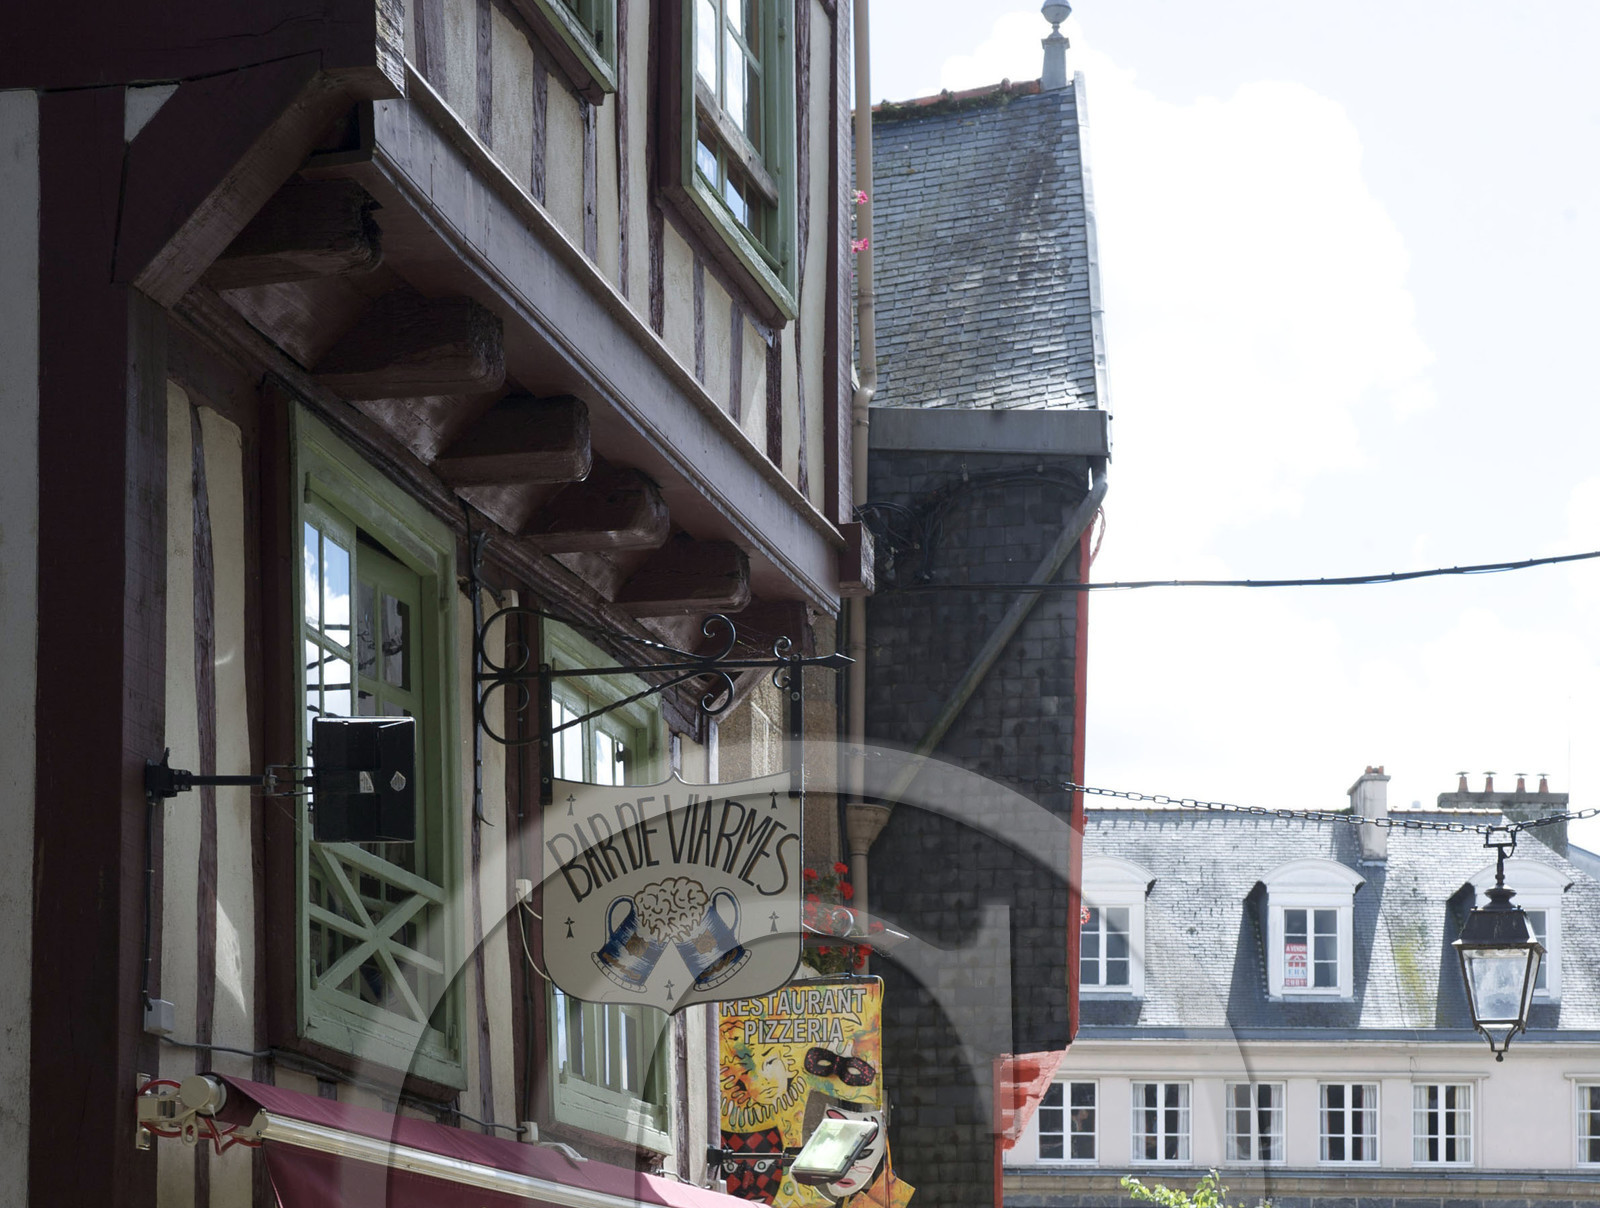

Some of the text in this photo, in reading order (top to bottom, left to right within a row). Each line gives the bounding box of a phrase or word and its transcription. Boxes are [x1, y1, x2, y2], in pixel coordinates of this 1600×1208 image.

[546, 792, 800, 903] BAR DE VIARMES
[721, 988, 867, 1017] RESTAURANT
[744, 1017, 844, 1045] PIZZERIA
